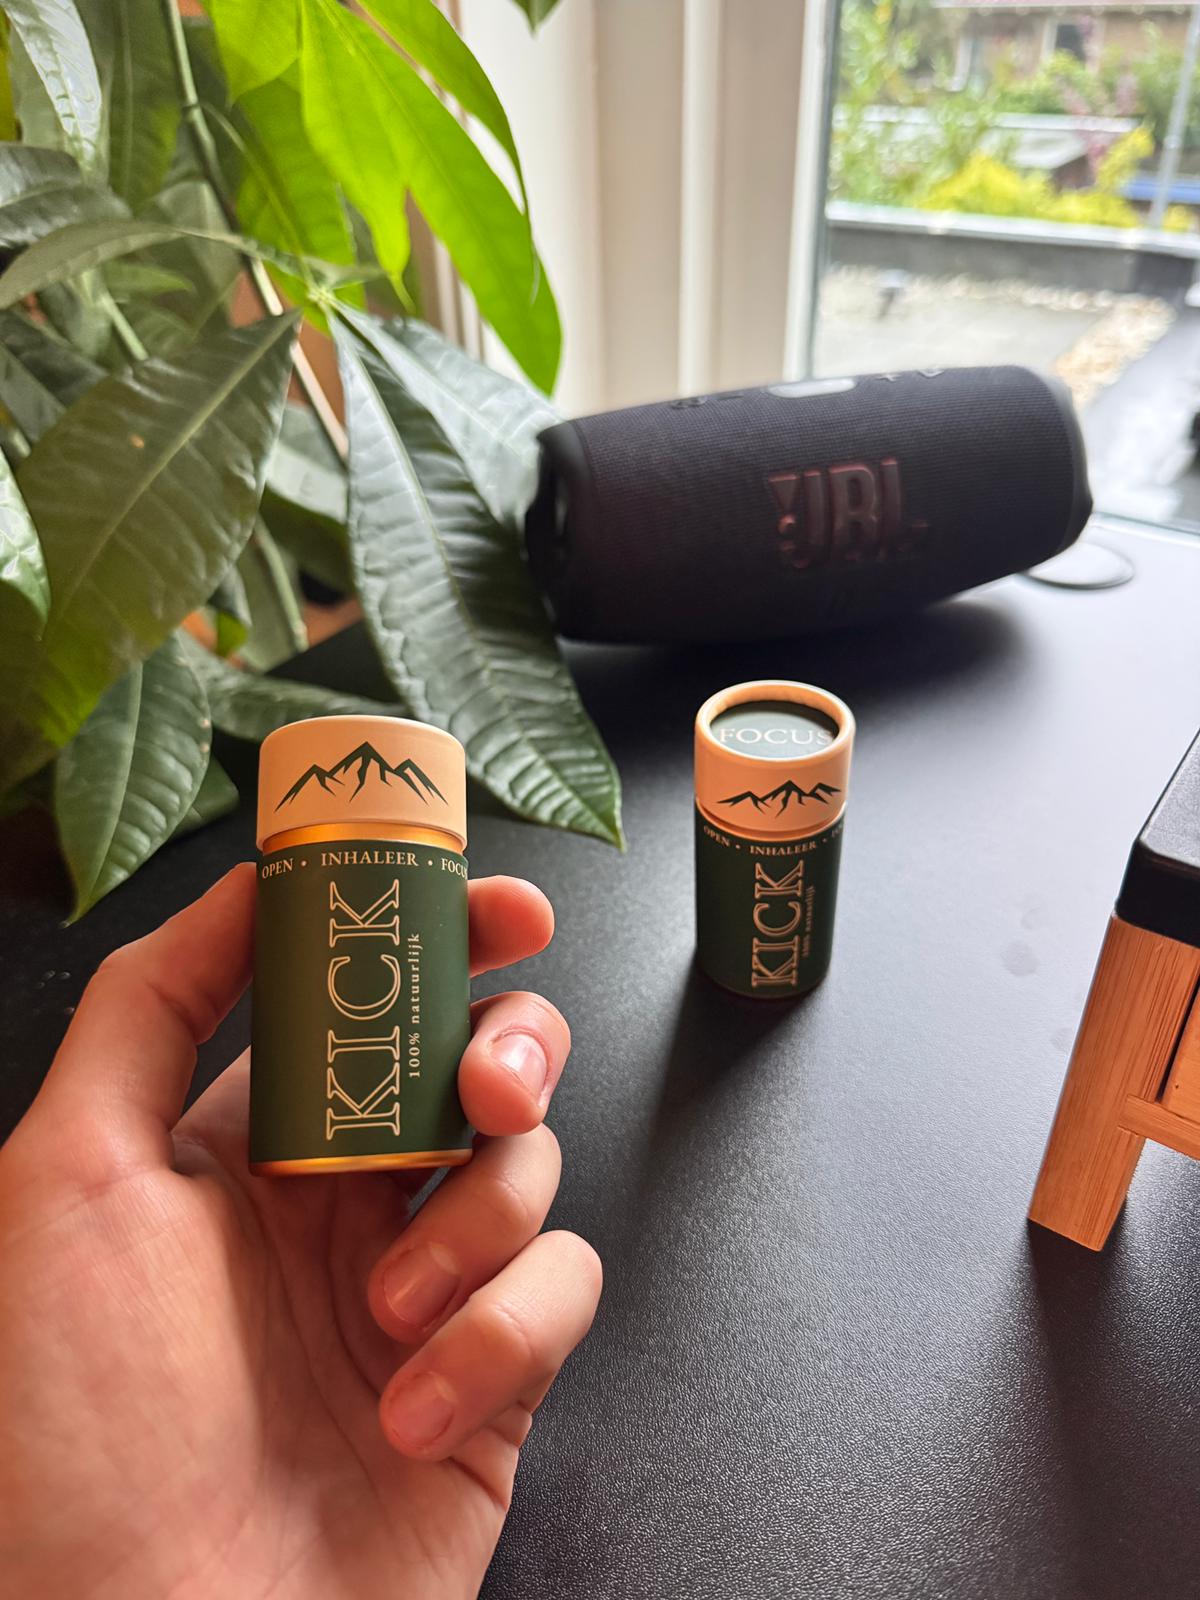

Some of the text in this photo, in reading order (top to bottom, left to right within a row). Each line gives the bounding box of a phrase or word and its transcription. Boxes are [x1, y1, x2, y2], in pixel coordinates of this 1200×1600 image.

[768, 457, 926, 568] JBL
[719, 728, 833, 746] FOCUS
[261, 858, 294, 879] OPEN
[321, 850, 419, 867] INHALEER
[703, 825, 817, 857] OPEN INHALEER
[751, 860, 804, 987] KICK
[326, 879, 401, 1141] KICK
[407, 933, 423, 1078] 100% natuurlijk
